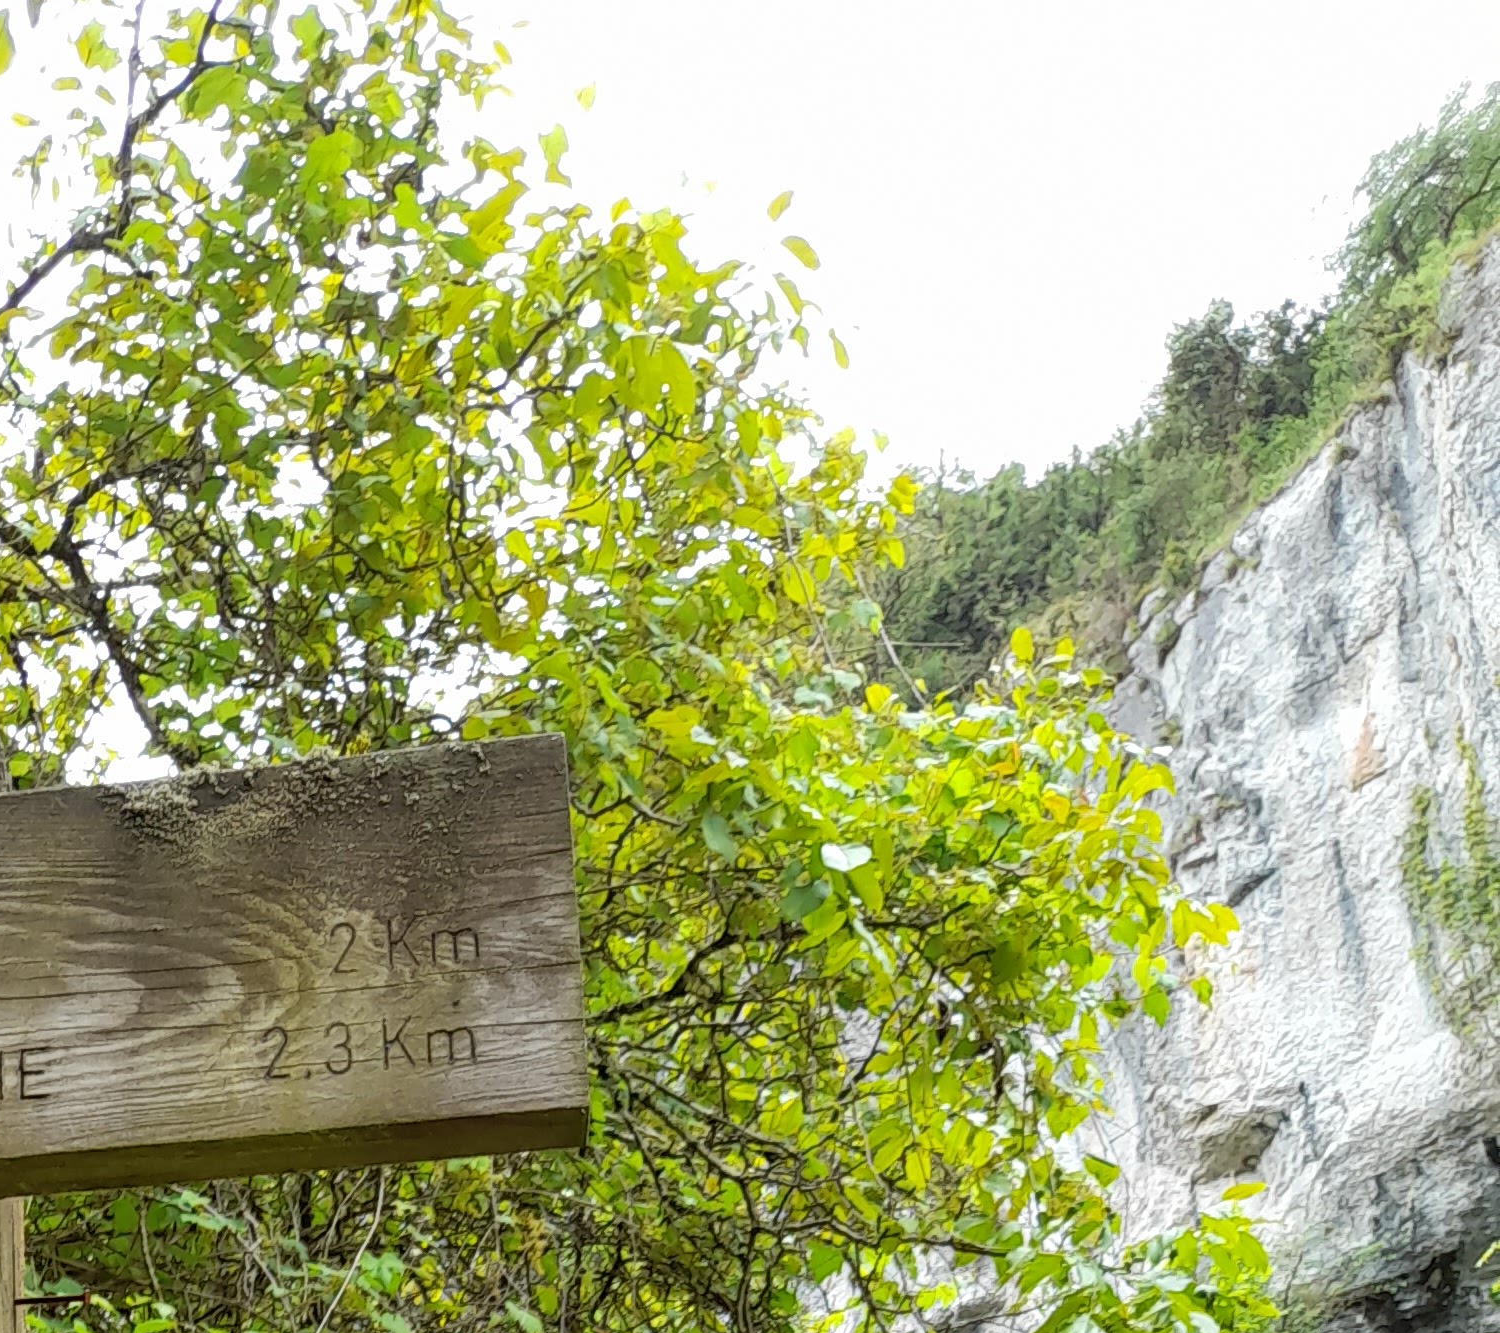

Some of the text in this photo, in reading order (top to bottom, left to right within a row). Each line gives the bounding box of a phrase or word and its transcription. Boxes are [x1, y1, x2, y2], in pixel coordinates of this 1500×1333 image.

[329, 922, 358, 976] 2
[386, 914, 480, 970] Km
[382, 1014, 478, 1072] Km
